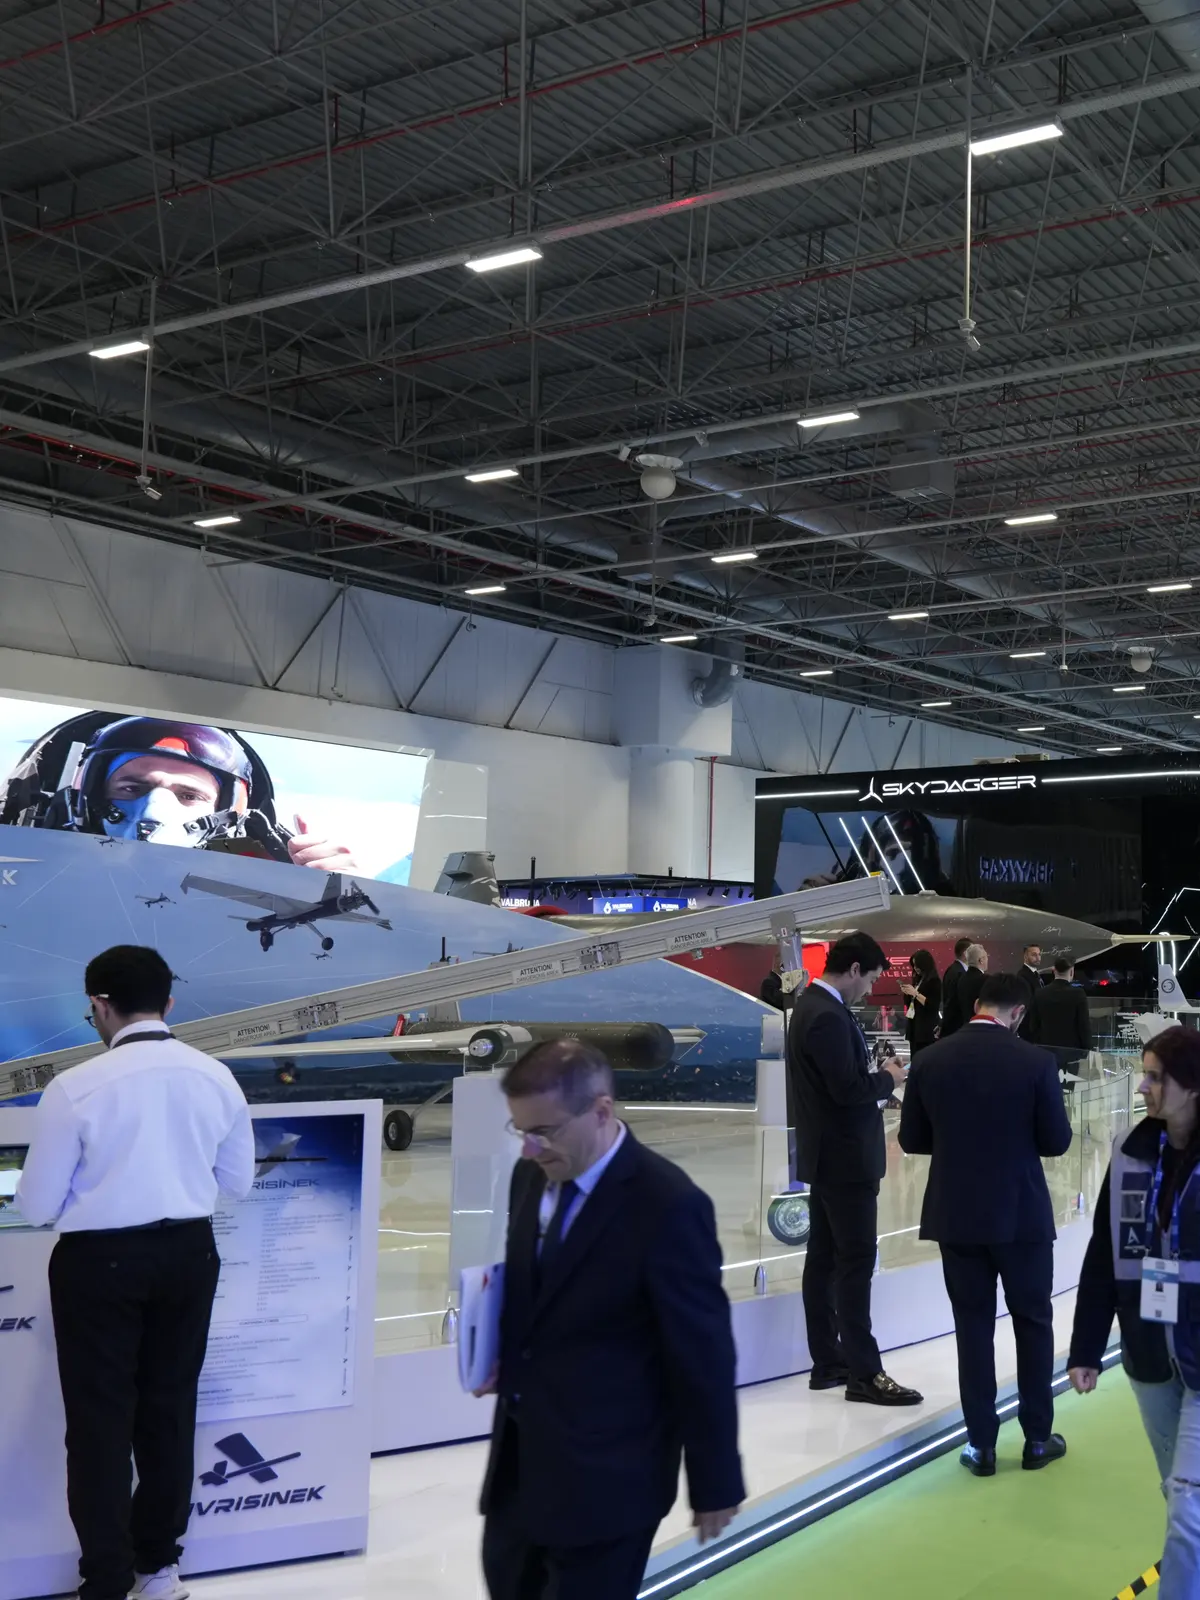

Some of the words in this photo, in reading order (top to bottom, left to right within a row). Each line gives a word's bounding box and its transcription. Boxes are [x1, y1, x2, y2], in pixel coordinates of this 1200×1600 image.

[882, 775, 1037, 797] SKYDAGGER
[674, 930, 707, 943] ATTENTION!
[520, 963, 553, 976] ATTENTION!
[237, 1023, 270, 1037] ATTENTION!
